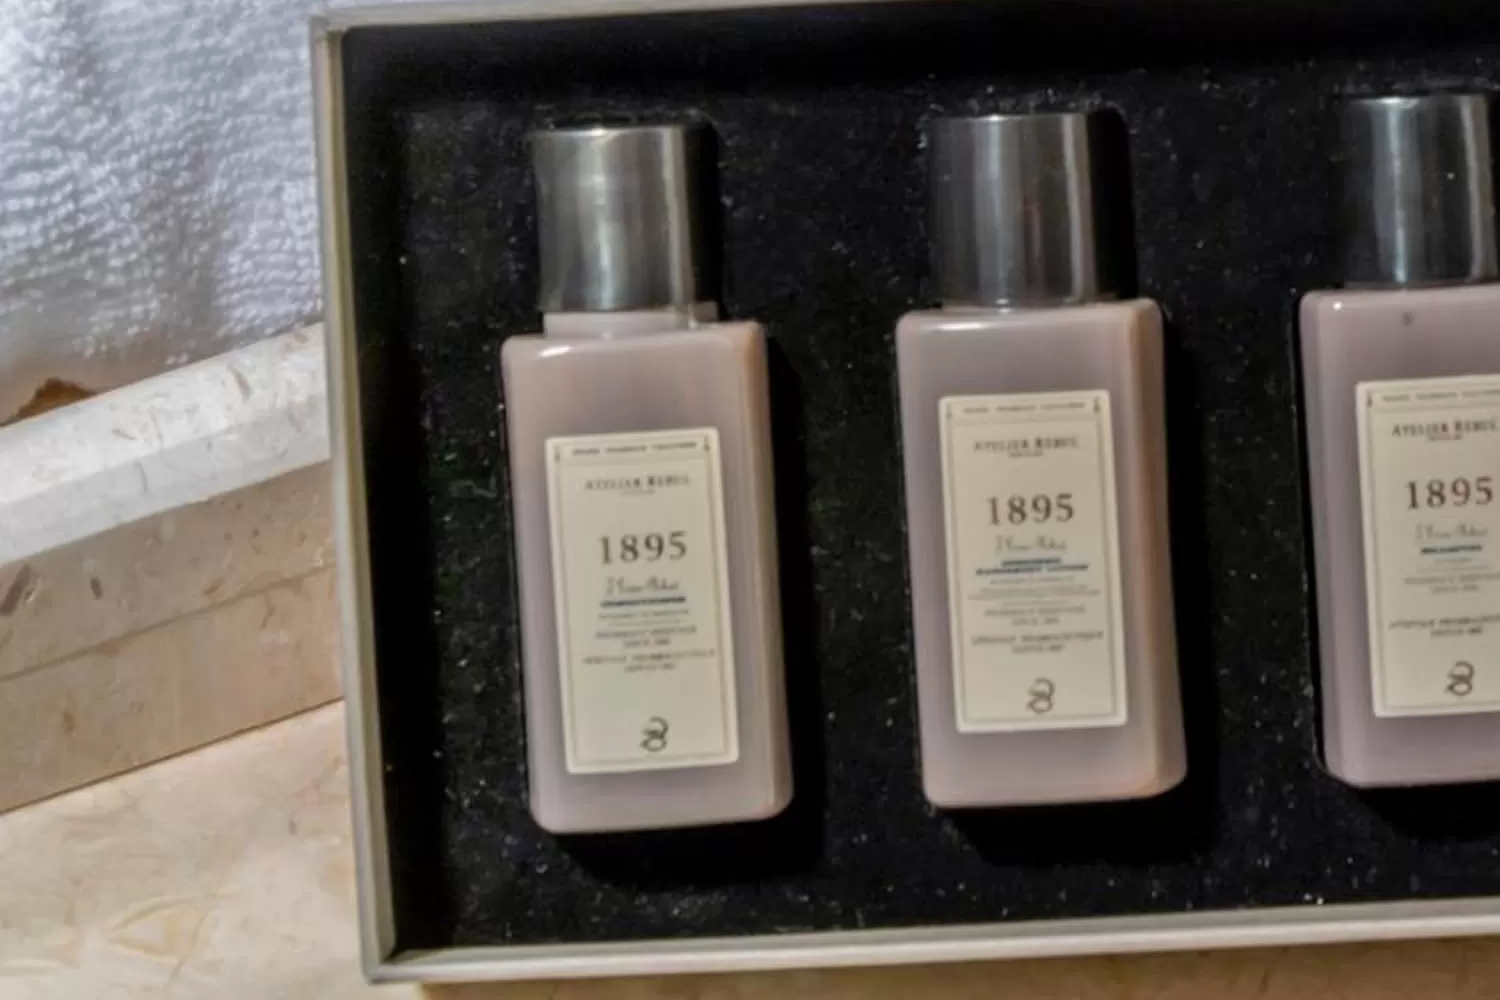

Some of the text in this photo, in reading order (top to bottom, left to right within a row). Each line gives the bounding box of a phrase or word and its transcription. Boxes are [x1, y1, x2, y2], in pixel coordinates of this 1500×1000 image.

[988, 493, 1075, 526] 1895
[1406, 476, 1494, 510] 1895
[600, 531, 688, 565] 1895
